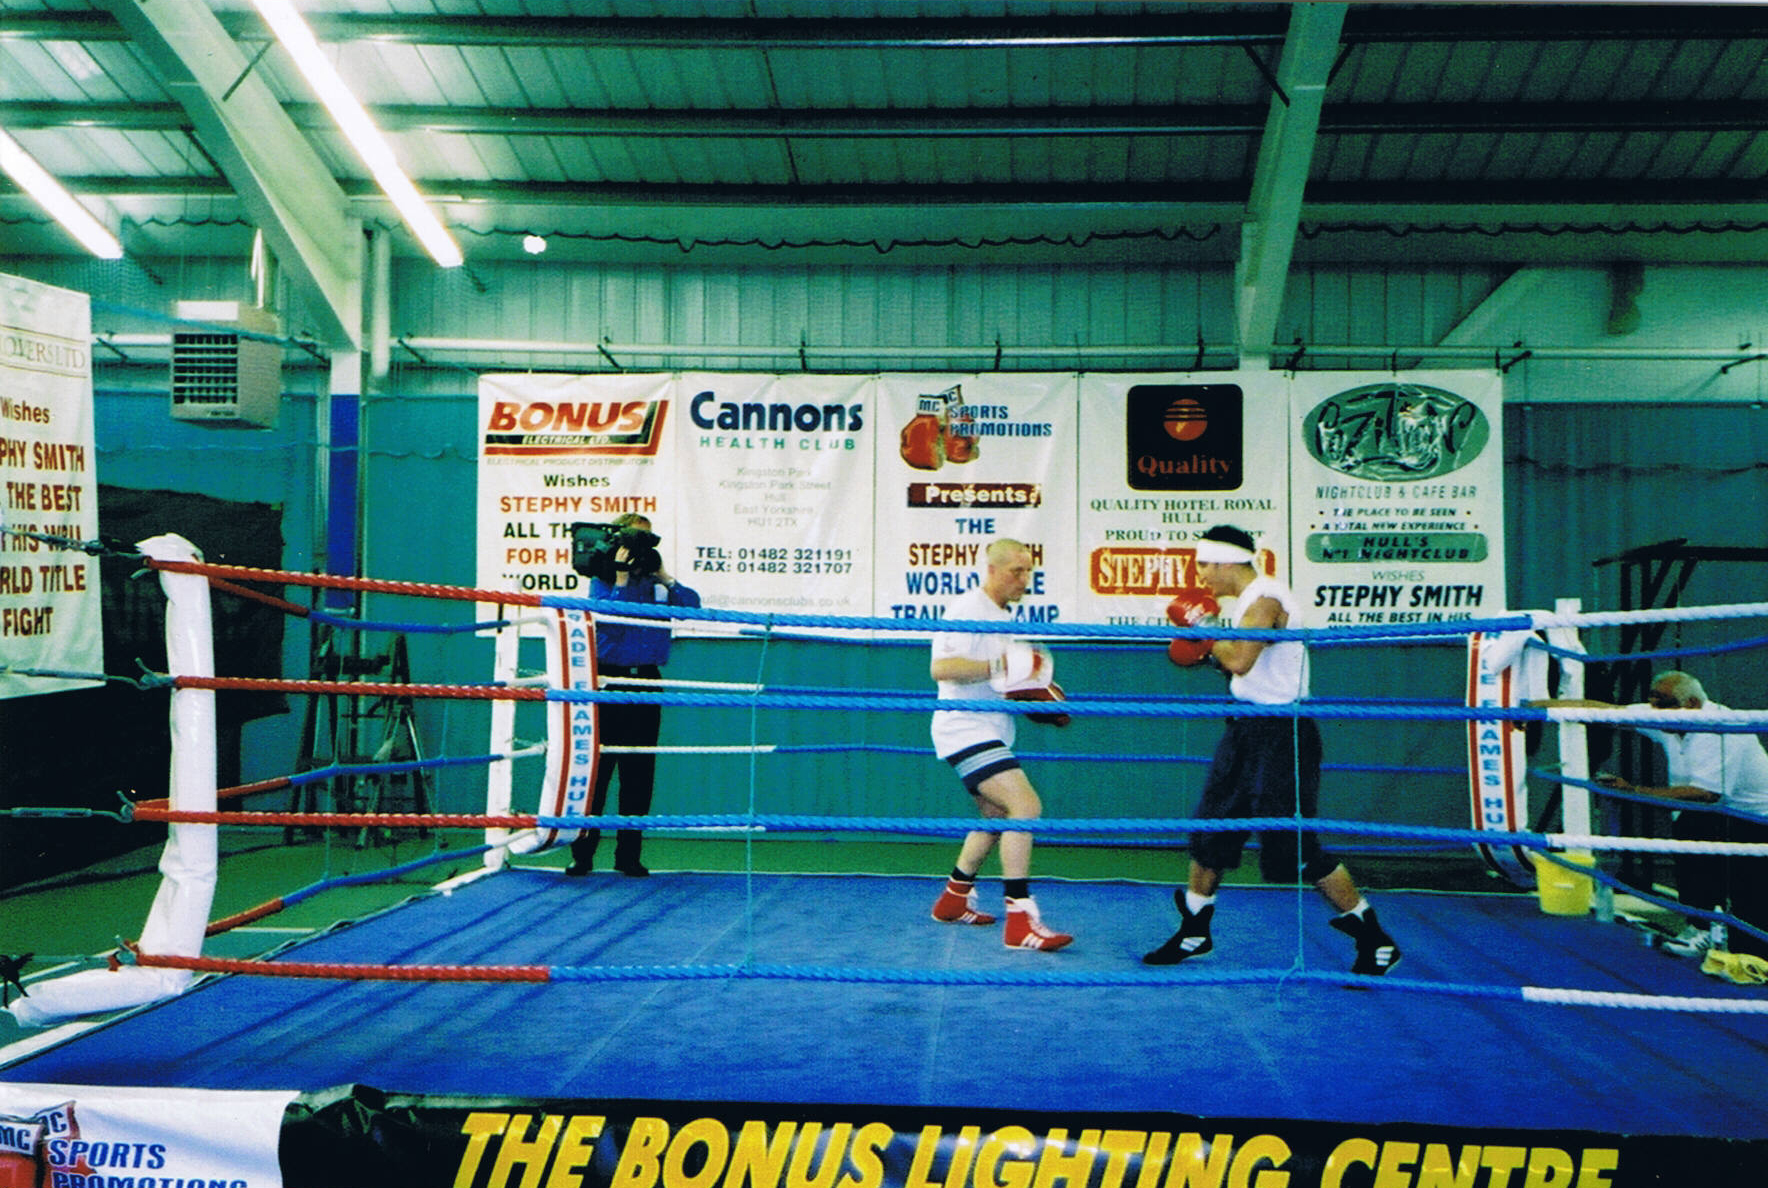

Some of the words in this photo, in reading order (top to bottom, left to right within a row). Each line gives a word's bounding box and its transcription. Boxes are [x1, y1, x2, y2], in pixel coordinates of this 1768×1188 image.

[488, 401, 647, 432] BONUS
[690, 391, 864, 432] Cannons
[951, 405, 1009, 419] SPORTS
[951, 422, 1053, 436] PROMOTIONS
[522, 434, 586, 444] ELECTRICAL
[700, 437, 785, 449] HEALTH
[799, 438, 855, 450] CLUB
[33, 441, 85, 472] SMITH
[1138, 455, 1232, 479] Quality
[544, 474, 610, 487] Wishes
[6, 481, 37, 510] THE
[41, 484, 82, 511] BEST
[1315, 486, 1391, 498] NIGHTCLUB
[1412, 486, 1445, 498] CAFE
[1452, 486, 1477, 498] BAR
[500, 496, 582, 512] STEPHY
[590, 496, 656, 513] SMITH
[1091, 499, 1160, 511] QUALITY
[1165, 499, 1220, 511] HOTEL
[1224, 499, 1276, 511] ROYAL
[1357, 508, 1390, 516] PLACE
[1395, 508, 1409, 516] TO
[1412, 508, 1426, 516] BE
[1430, 508, 1456, 516] SEEN
[1162, 512, 1206, 523] HULL
[504, 522, 540, 538] ALL
[549, 523, 573, 538] TH
[955, 518, 996, 534] THE
[1372, 522, 1397, 530] NEW
[1401, 522, 1465, 530] EXPERIENCE
[1106, 529, 1161, 541] PROUD
[1168, 530, 1191, 541] TO
[1363, 536, 1429, 547] HULL'S
[506, 548, 546, 564] FOR
[697, 547, 732, 559] TEL:
[738, 548, 788, 559] 01482
[794, 549, 852, 560] 321191
[909, 544, 979, 566] STEPHY
[1358, 549, 1470, 559] NIGHTCLUB
[693, 561, 731, 572] FAX:
[737, 562, 787, 573] 01482
[793, 562, 852, 574] 321707
[1098, 553, 1191, 588] STEPHY
[1372, 570, 1425, 581] WISHES
[39, 565, 86, 593] TITLE
[502, 574, 578, 590] ORLD
[1315, 585, 1403, 607] STEPHY
[1409, 585, 1484, 607] SMITH
[3, 607, 53, 636] FIGHT
[1006, 605, 1060, 623] AMP
[1327, 612, 1352, 622] ALL
[1358, 612, 1384, 622] THE
[1389, 612, 1422, 622] BEST
[1427, 612, 1443, 623] IN
[1448, 612, 1472, 621] HIS
[50, 1139, 166, 1169] SPORTS
[453, 1113, 605, 1188] THE
[611, 1117, 894, 1188] BONUS
[907, 1126, 1292, 1188] LIGHTING
[1319, 1138, 1619, 1188] CENTRE
